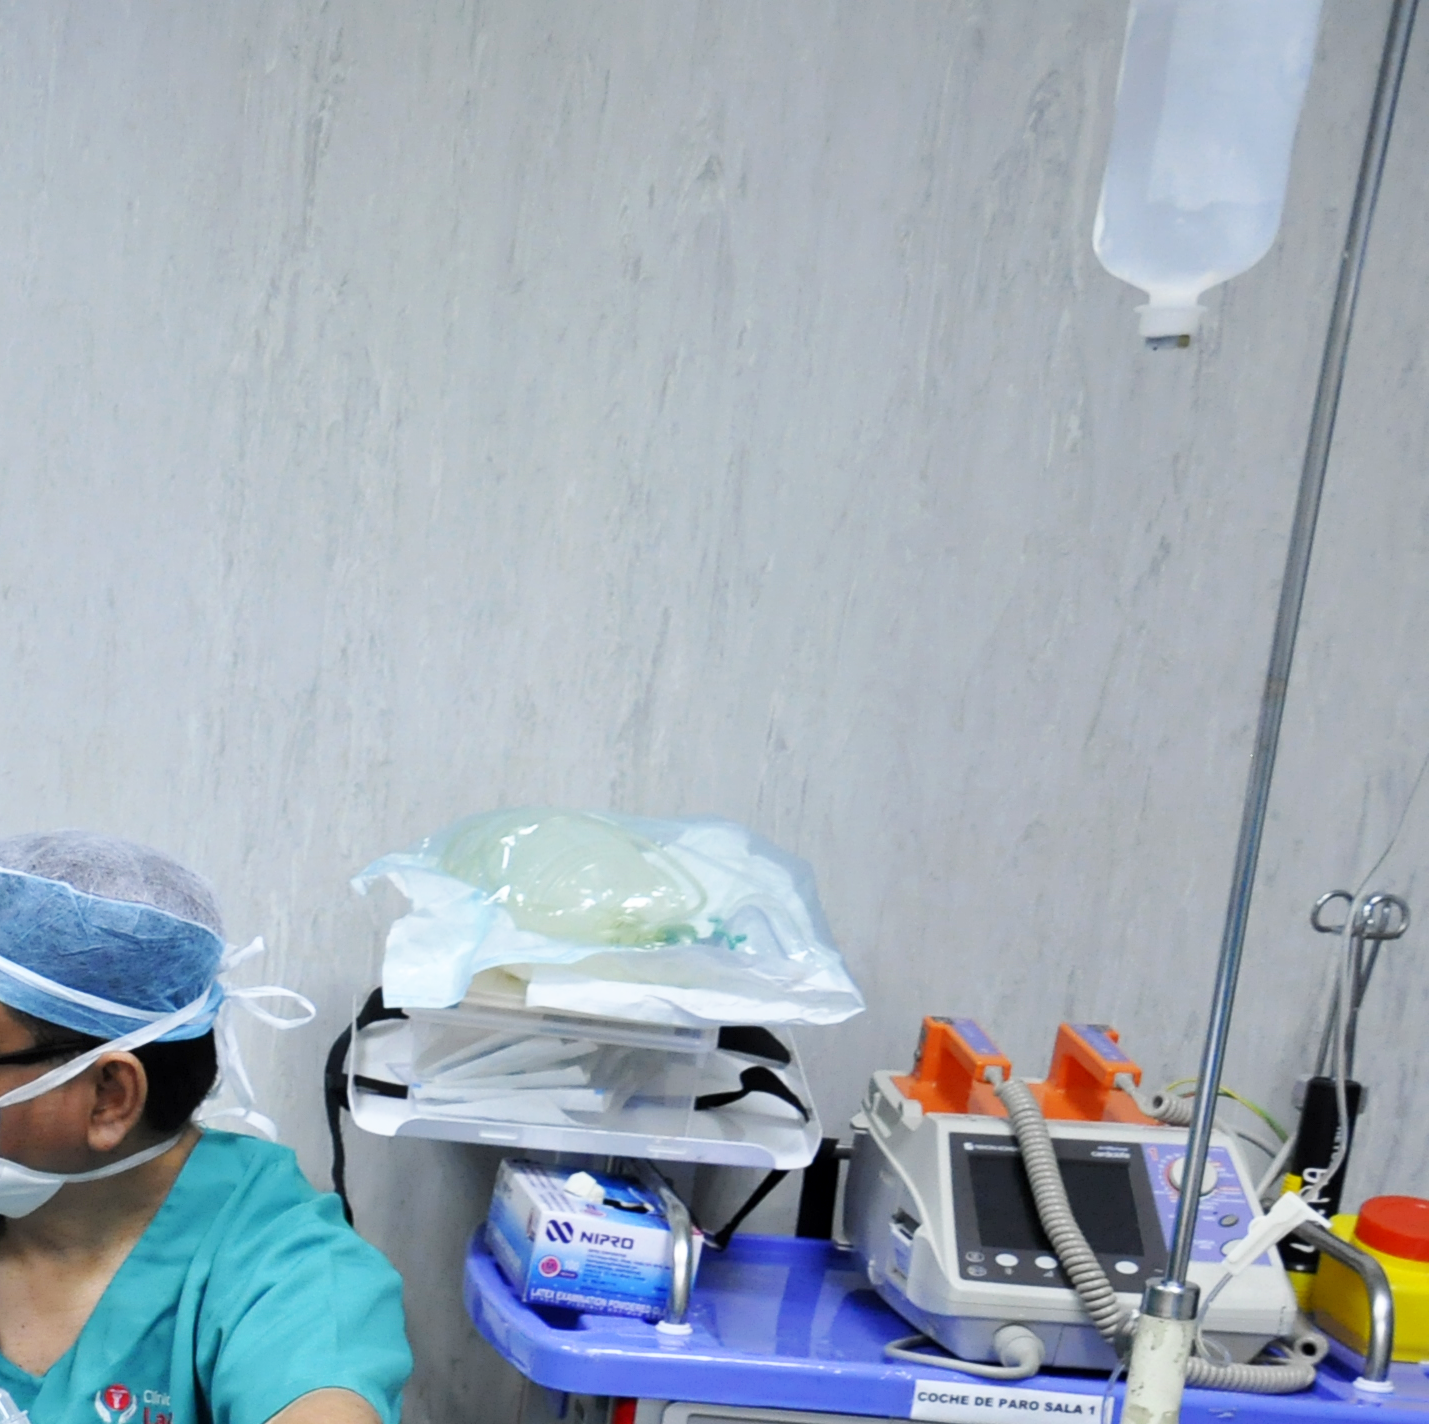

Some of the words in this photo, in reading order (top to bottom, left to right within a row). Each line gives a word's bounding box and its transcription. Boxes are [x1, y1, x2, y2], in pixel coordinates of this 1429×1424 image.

[580, 1231, 635, 1250] NIPRO
[143, 1389, 171, 1406] Clínic
[917, 1391, 970, 1405] COCHE
[974, 1396, 992, 1407] DE
[998, 1398, 1040, 1411] PARO
[1044, 1401, 1083, 1415] SALA
[1088, 1405, 1096, 1416] 1
